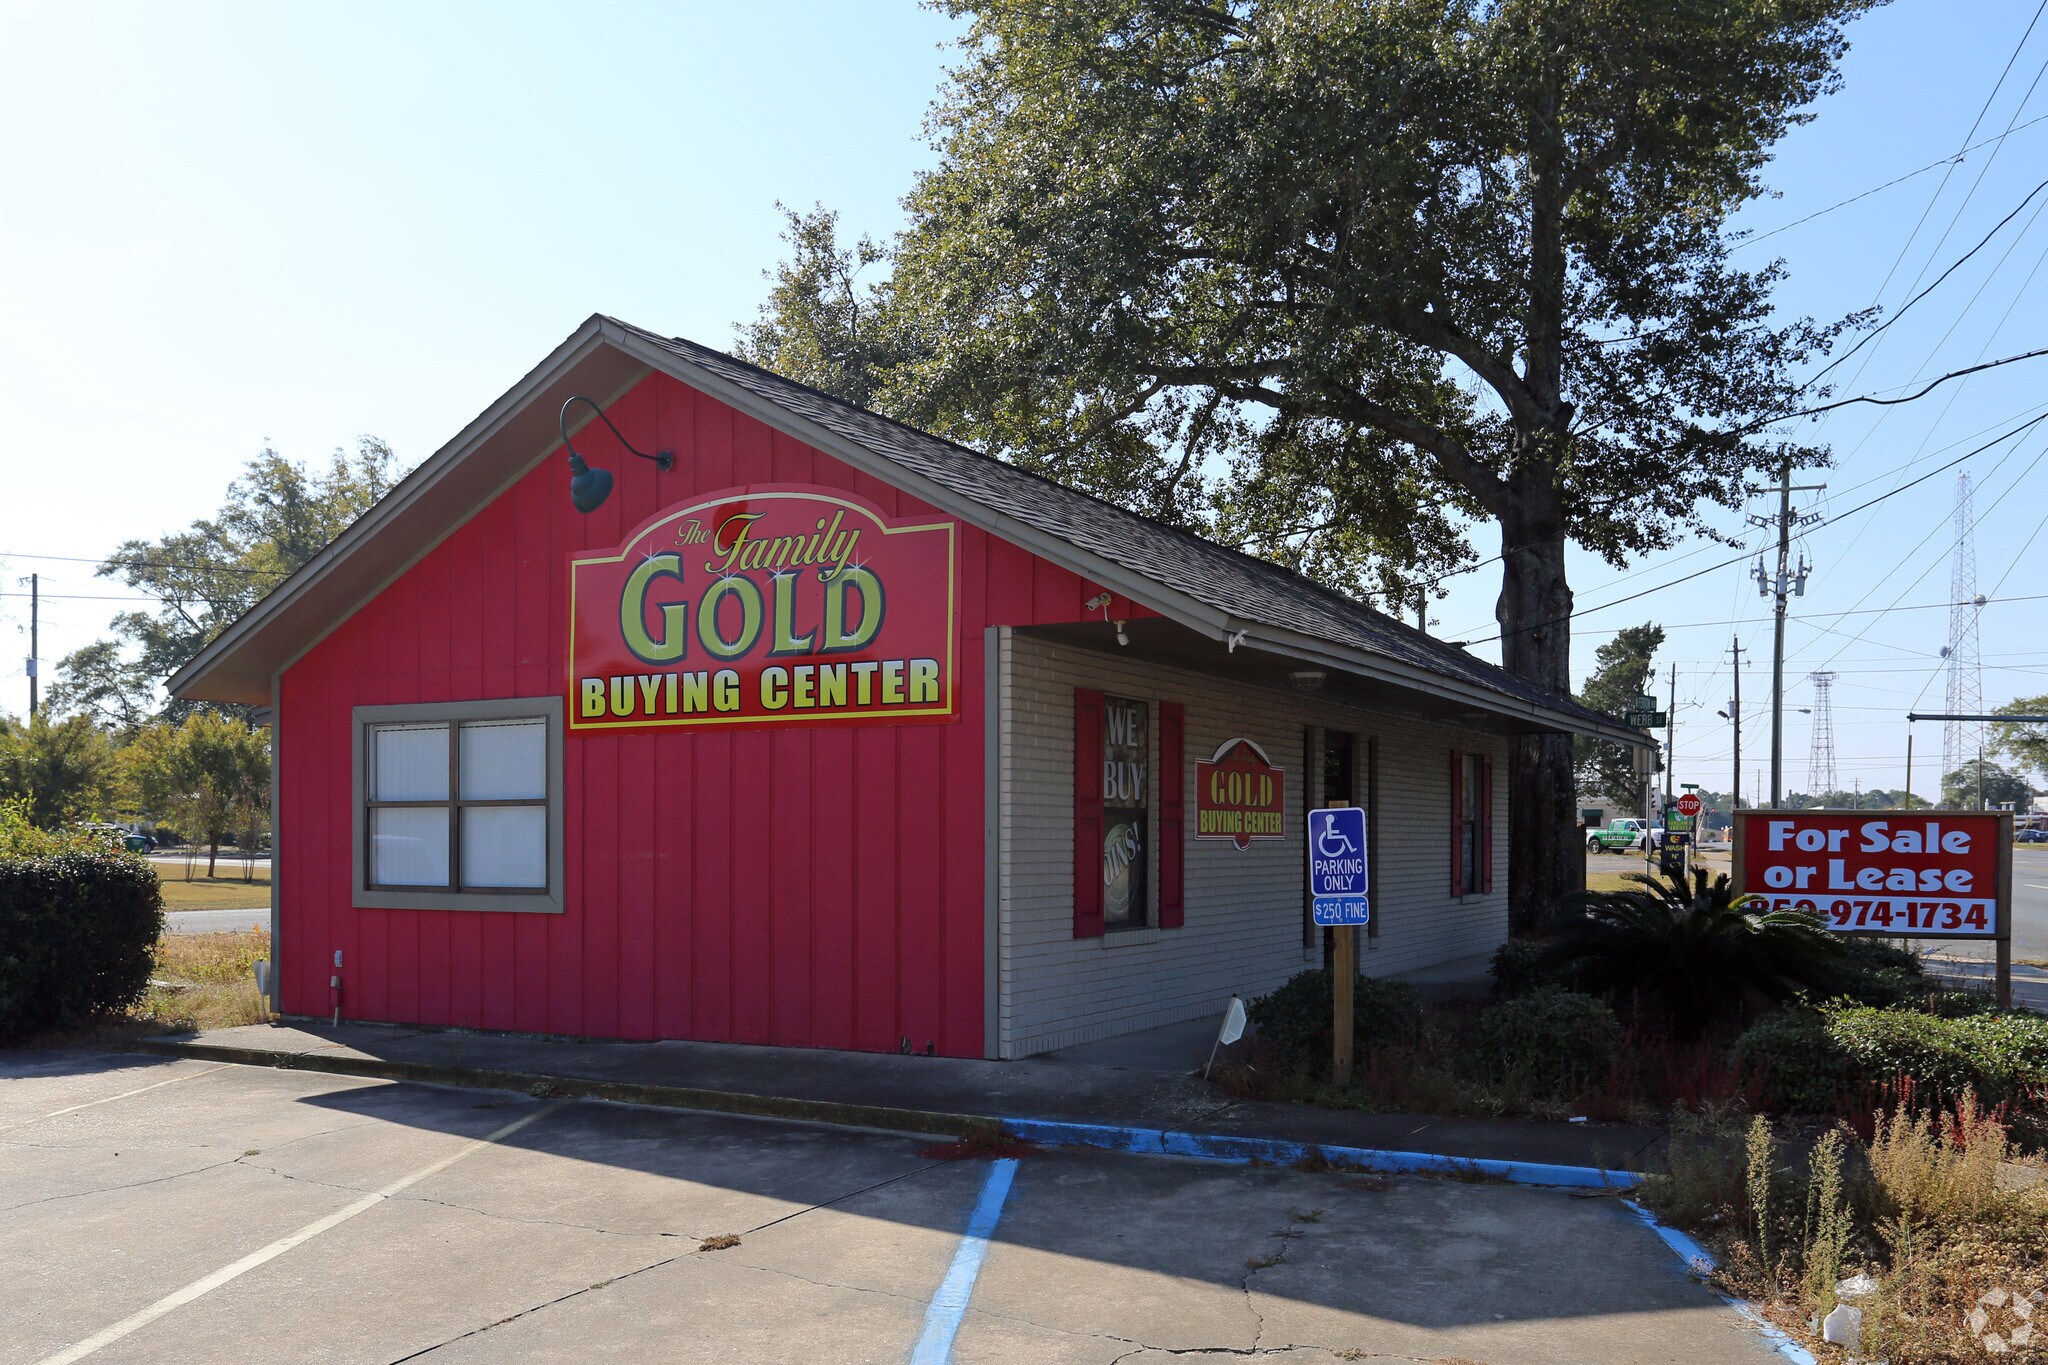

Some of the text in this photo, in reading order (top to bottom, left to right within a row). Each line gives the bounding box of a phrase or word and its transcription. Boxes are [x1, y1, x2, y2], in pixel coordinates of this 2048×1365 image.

[675, 509, 862, 582] The Family
[619, 551, 887, 667] GOLD
[580, 658, 941, 718] BUYING CENTER
[1106, 706, 1138, 748] WE
[1629, 714, 1663, 727] WEBB ST
[1103, 760, 1145, 801] BUY
[1210, 769, 1274, 808] GOLD
[1199, 809, 1282, 834] BUYING CENTER
[1678, 800, 1700, 810] STOP
[1103, 821, 1141, 886] OINS!
[1664, 844, 1685, 852] WASH
[1767, 820, 1972, 854] For Sale
[1314, 858, 1363, 875] PARKING
[1324, 875, 1354, 892] ONLY
[1763, 858, 1974, 893] or Lease
[1315, 902, 1367, 920] $250 FINE
